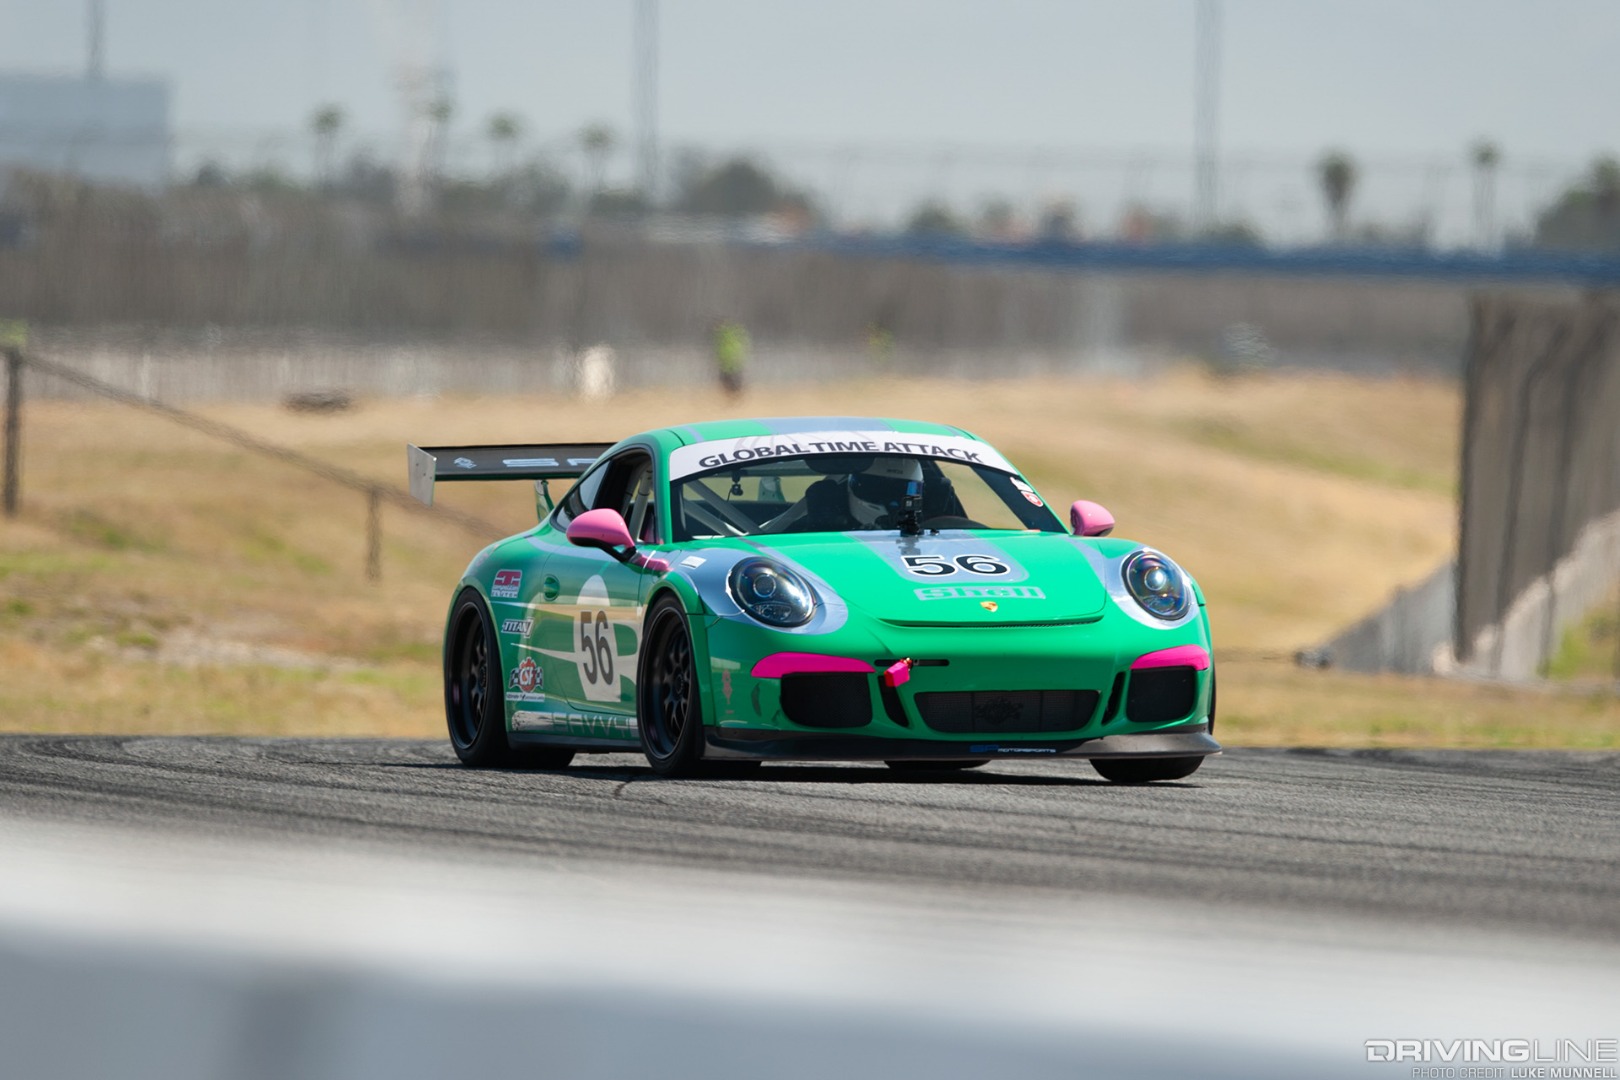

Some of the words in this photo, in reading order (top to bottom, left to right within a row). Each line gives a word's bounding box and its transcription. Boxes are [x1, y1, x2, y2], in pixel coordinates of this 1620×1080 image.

[699, 443, 812, 469] GLOBAL
[809, 441, 880, 453] TIME
[883, 442, 983, 463] ATTACK
[901, 554, 1011, 577] 56
[920, 587, 1043, 600] Shell
[581, 610, 614, 685] 56
